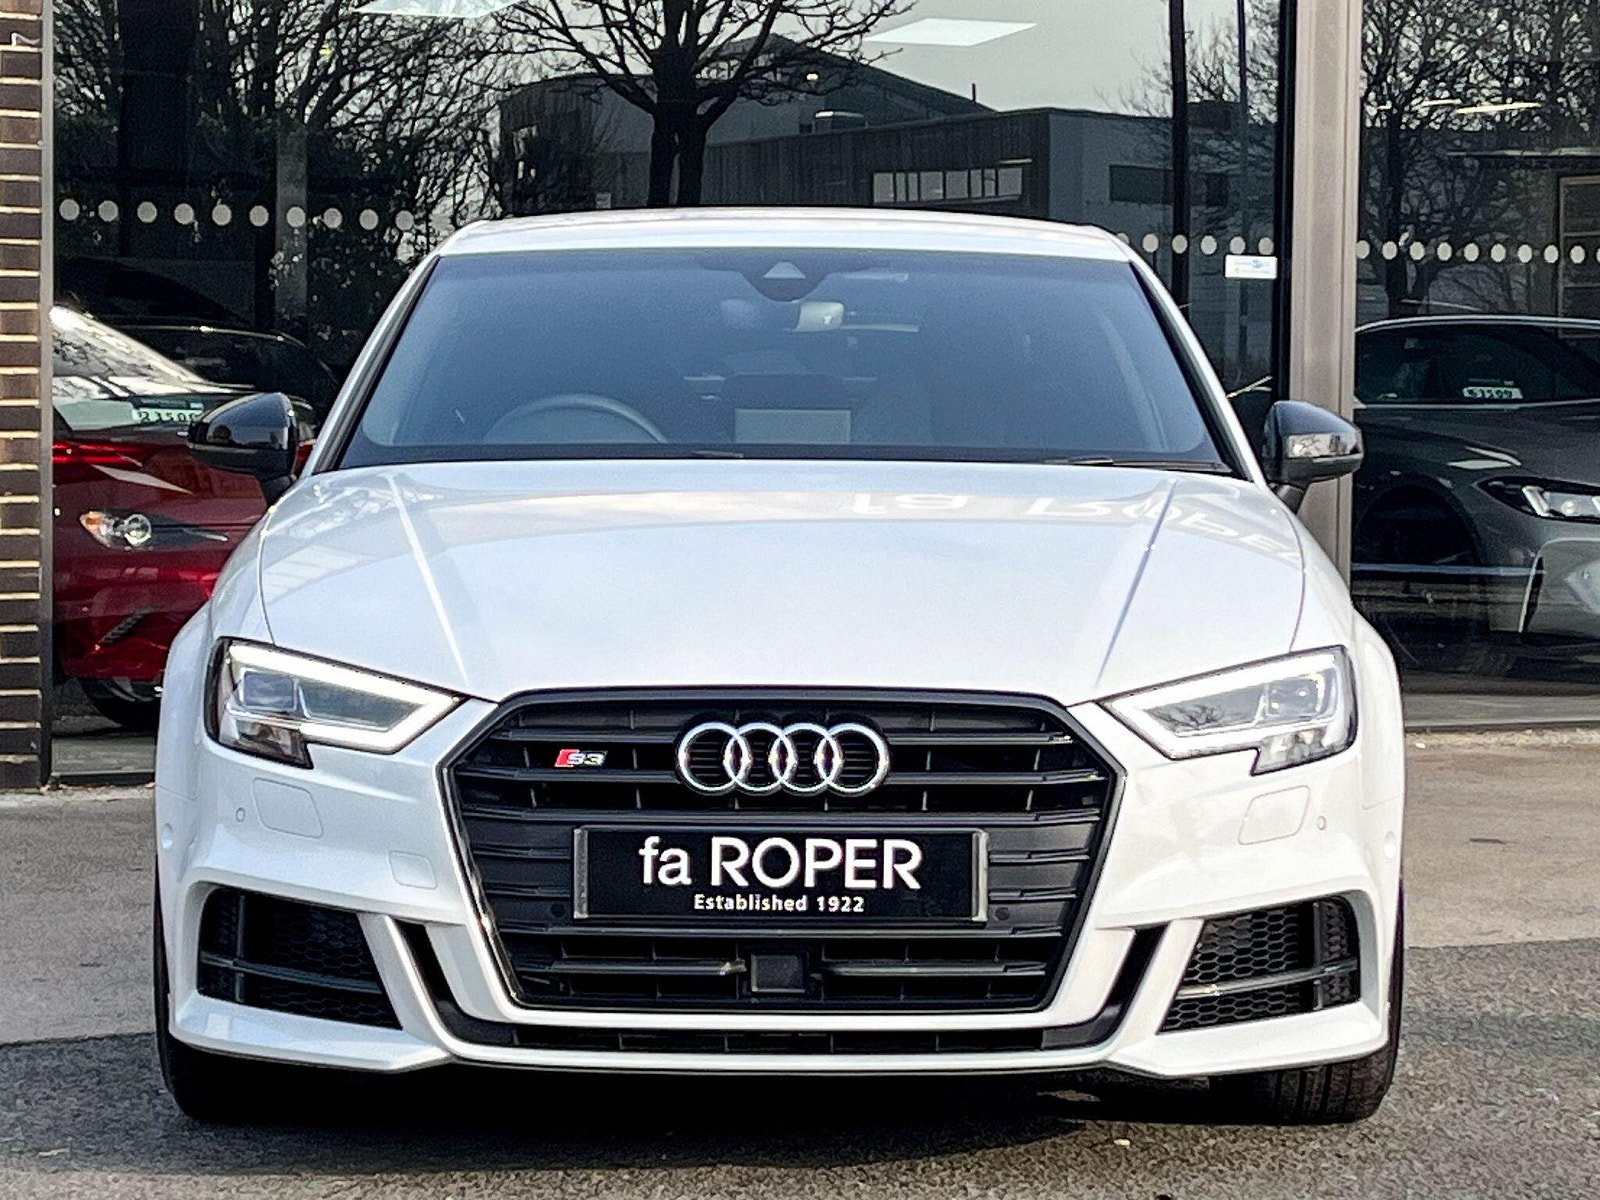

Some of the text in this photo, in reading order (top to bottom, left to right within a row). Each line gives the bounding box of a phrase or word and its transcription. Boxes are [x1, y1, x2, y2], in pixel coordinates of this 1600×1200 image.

[565, 752, 606, 770] S3
[638, 835, 923, 890] fa ROPER
[693, 893, 865, 913] Established 1922
